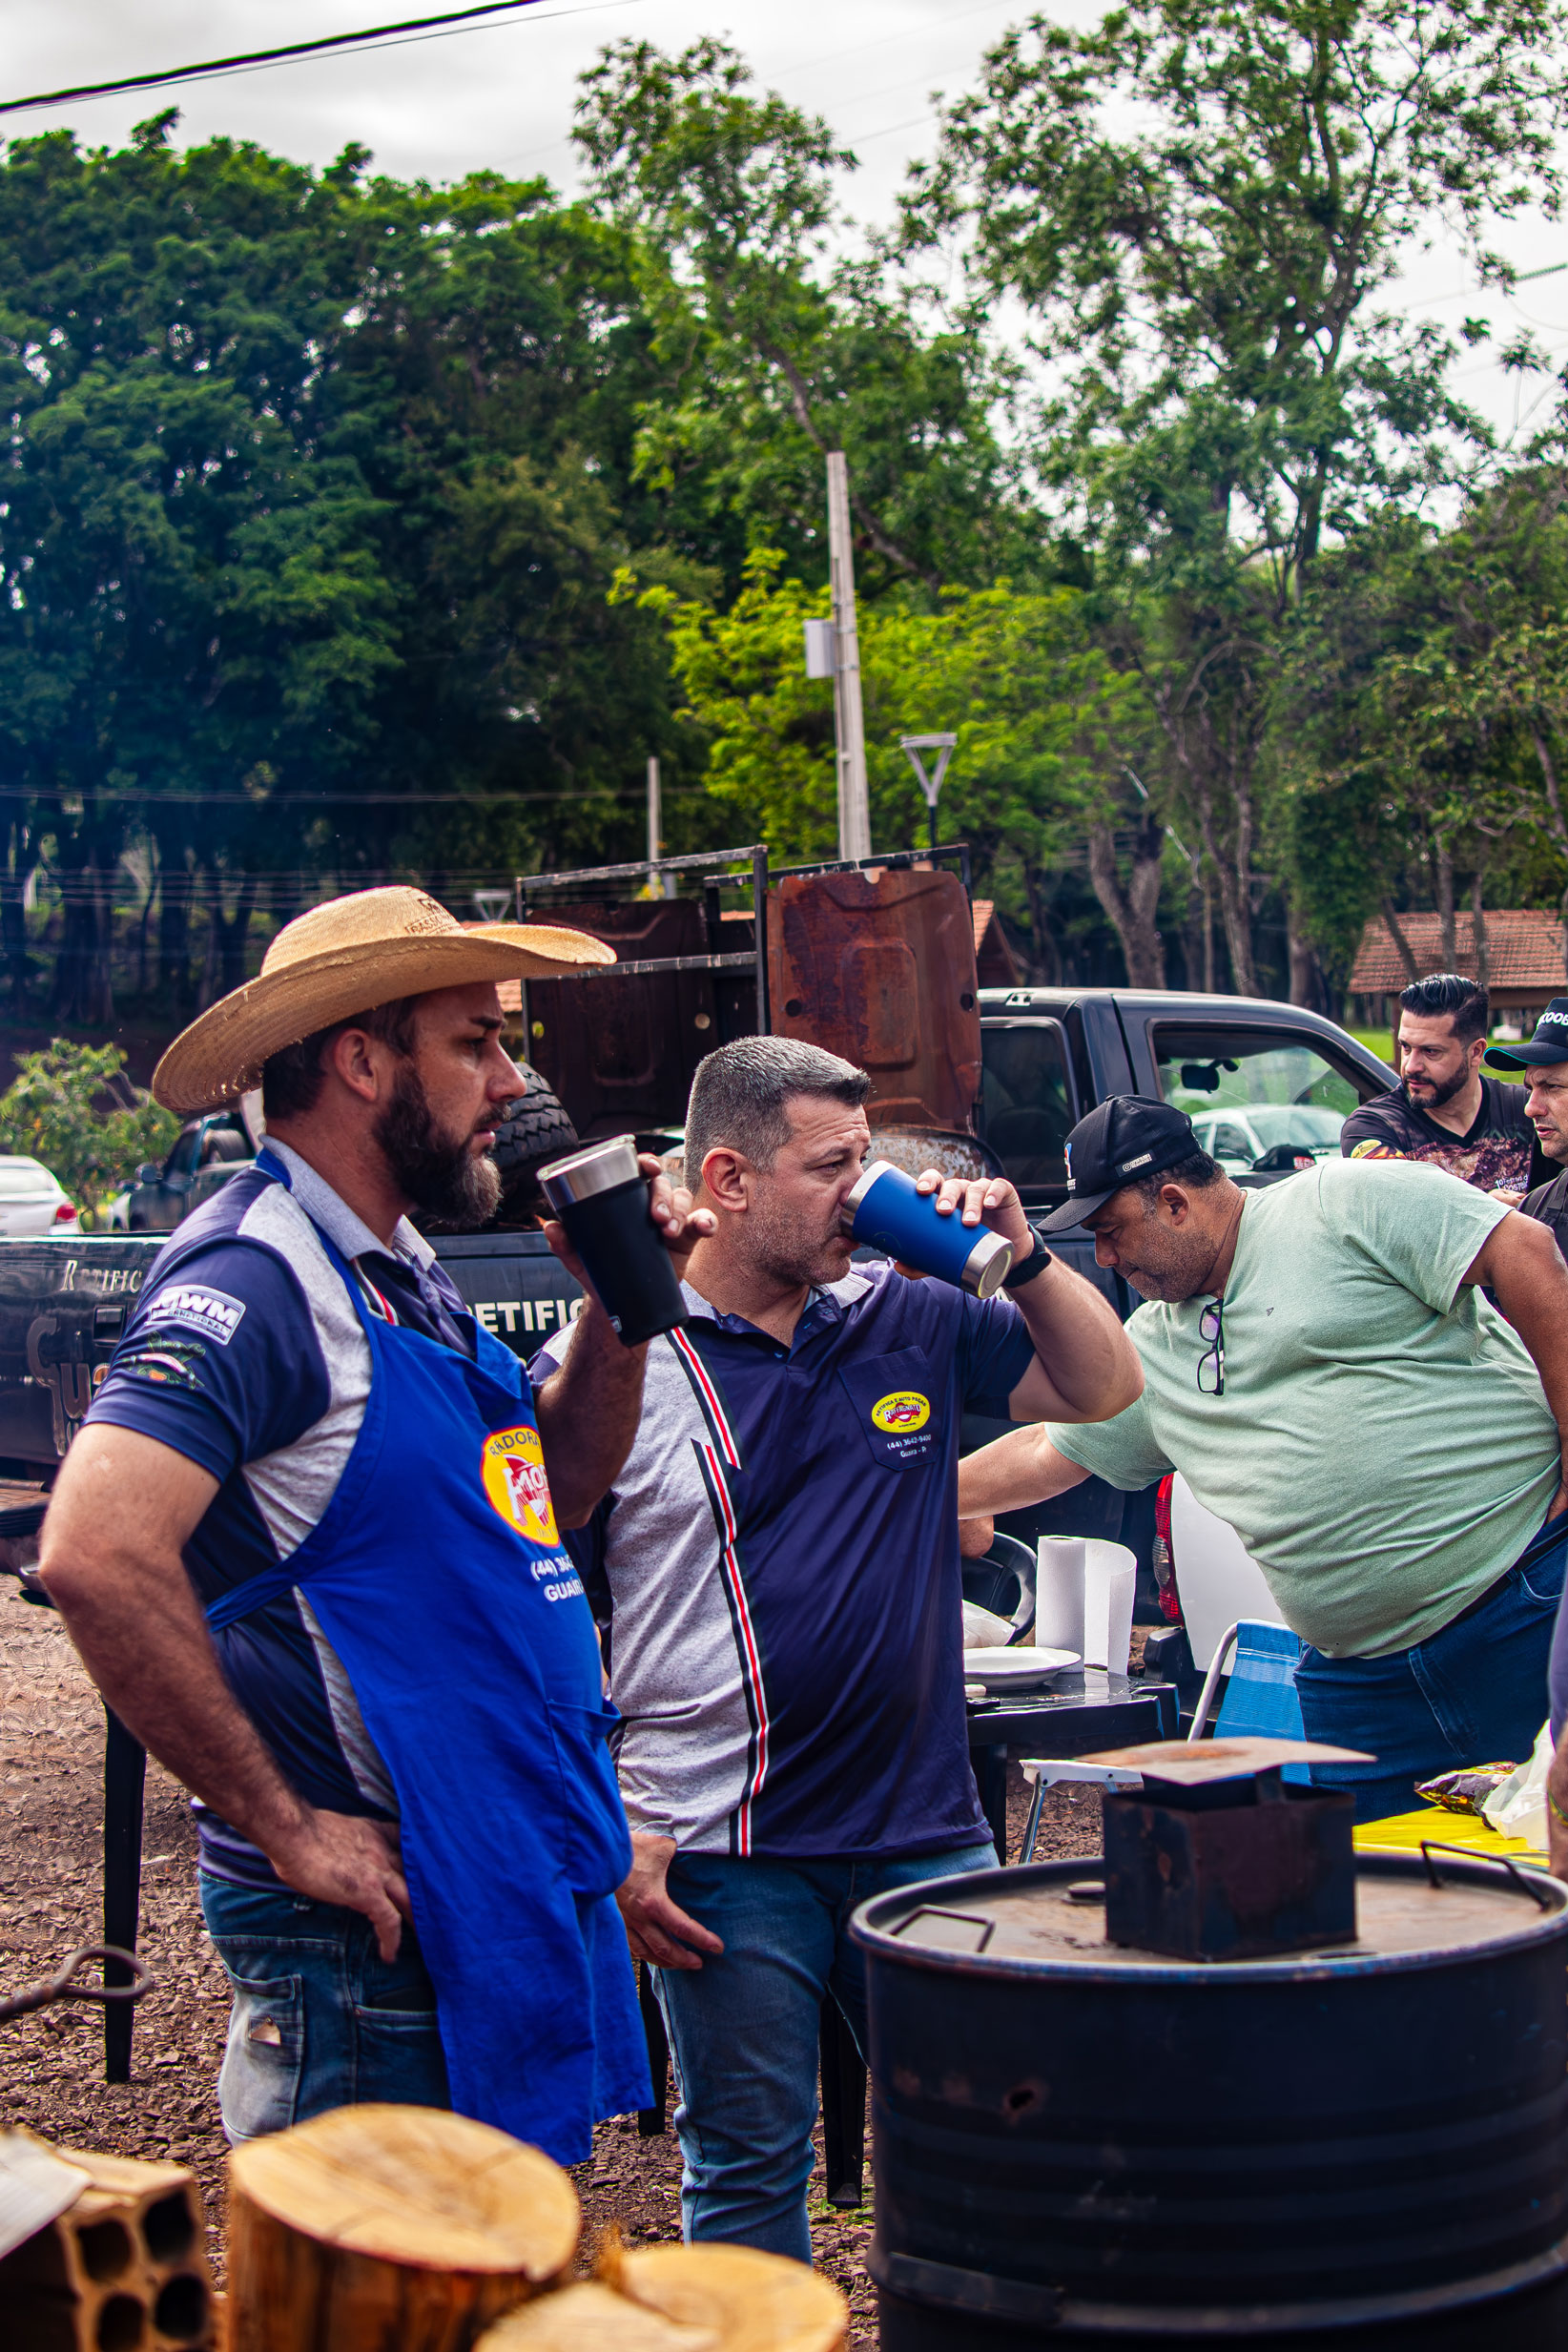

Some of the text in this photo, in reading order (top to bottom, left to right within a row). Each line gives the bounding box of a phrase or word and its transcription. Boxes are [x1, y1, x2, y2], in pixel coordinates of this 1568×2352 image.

[152, 1292, 240, 1327] MWM
[887, 1440, 902, 1451] (44)
[530, 1558, 559, 1582] (44)
